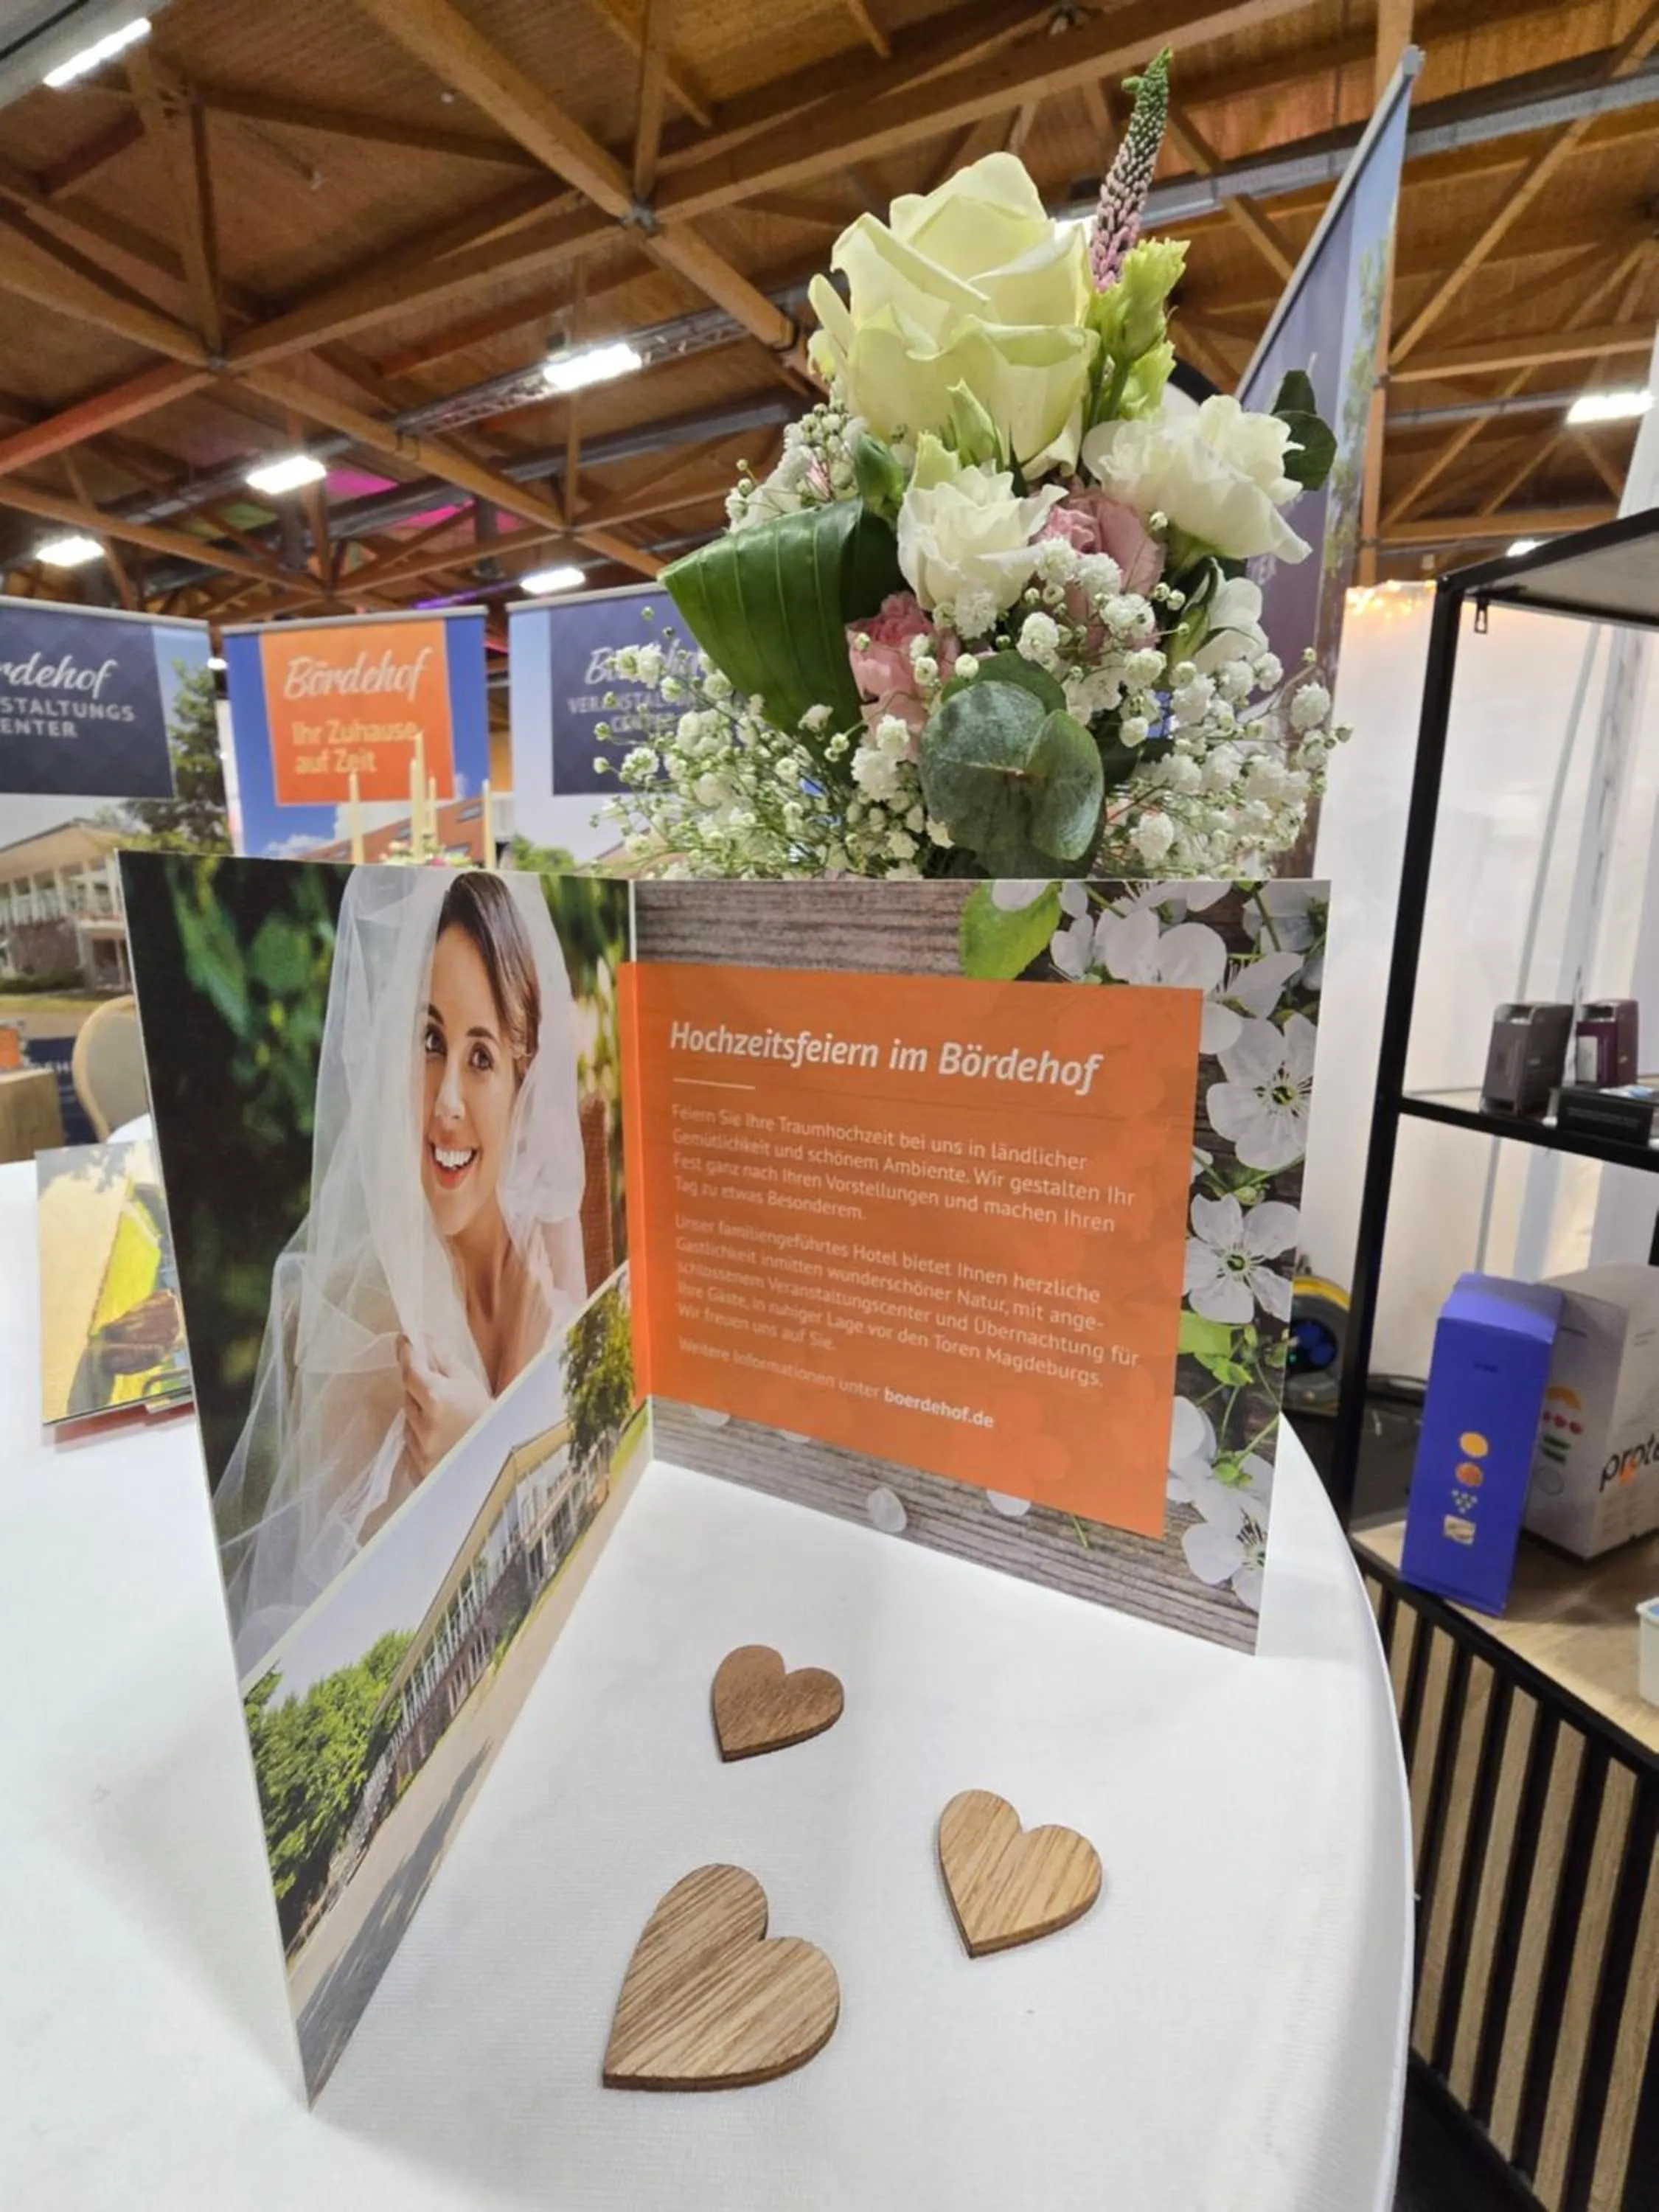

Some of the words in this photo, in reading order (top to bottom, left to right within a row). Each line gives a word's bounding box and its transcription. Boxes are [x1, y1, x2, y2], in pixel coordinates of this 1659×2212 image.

[0, 696, 136, 723] STALTUNGS
[283, 647, 434, 702] Bördehof
[0, 717, 78, 738] ENTER
[292, 720, 322, 745] Ihr
[326, 718, 420, 744] Zuhause
[296, 748, 329, 774] auf
[334, 746, 377, 773] Zeit
[669, 1020, 880, 1068] Hochzeitsfeiern
[889, 1037, 928, 1071] im
[938, 1041, 1104, 1096] Bördehof
[671, 1103, 716, 1125] Feiern
[719, 1108, 742, 1127] Sie
[745, 1111, 775, 1133] Ihre
[779, 1116, 895, 1147] Traumhochzeit
[899, 1133, 926, 1150] bei
[931, 1139, 963, 1156] uns
[968, 1138, 986, 1159] in
[991, 1141, 1088, 1172] ländlicher
[672, 1127, 771, 1158] Gemütlichkeit
[774, 1143, 804, 1162] und
[807, 1148, 880, 1172] schönem
[883, 1156, 970, 1185] Ambiente.
[973, 1167, 1006, 1189] Wir
[1009, 1175, 1101, 1203] gestalten
[1107, 1185, 1136, 1207] Ihr
[672, 1151, 703, 1172] Fest
[705, 1160, 740, 1178] ganz
[742, 1165, 779, 1181] nach
[782, 1167, 822, 1189] Ihren
[824, 1172, 940, 1207] Vorstellungen
[944, 1193, 979, 1213] und
[984, 1200, 1057, 1225] machen
[1064, 1208, 1116, 1234] Ihren
[672, 1175, 698, 1197] Tag
[701, 1183, 719, 1197] zu
[720, 1185, 765, 1205] etwas
[767, 1189, 866, 1221] Besonderem.
[674, 1211, 715, 1234] Unser
[718, 1220, 848, 1259] familiengeführtes
[852, 1243, 897, 1267] Hotel
[902, 1251, 953, 1277] bietet
[957, 1261, 1008, 1287] Ihnen
[1012, 1272, 1101, 1304] herzliche
[760, 1251, 823, 1279] inmitten
[827, 1265, 953, 1303] wunderschöner
[956, 1285, 1010, 1318] Natur,
[1012, 1301, 1045, 1321] mit
[1049, 1309, 1104, 1333] ange-
[703, 1306, 750, 1330] freuen
[752, 1321, 778, 1338] uns
[781, 1328, 806, 1343] auf
[751, 1296, 767, 1312] in
[768, 1302, 822, 1326] ruhiger
[827, 1312, 864, 1336] Lage
[867, 1324, 893, 1338] vor
[897, 1328, 929, 1348] den
[933, 1332, 981, 1360] Toren
[985, 1346, 1103, 1388] Magdeburgs.
[766, 1276, 931, 1324] Veranstaltungscenter
[935, 1312, 969, 1332] und
[973, 1312, 1105, 1364] Übernachtung
[1110, 1343, 1140, 1368] für
[732, 1349, 835, 1389] Informationen
[838, 1378, 880, 1399] unter
[885, 1386, 994, 1429] boerdehof.de
